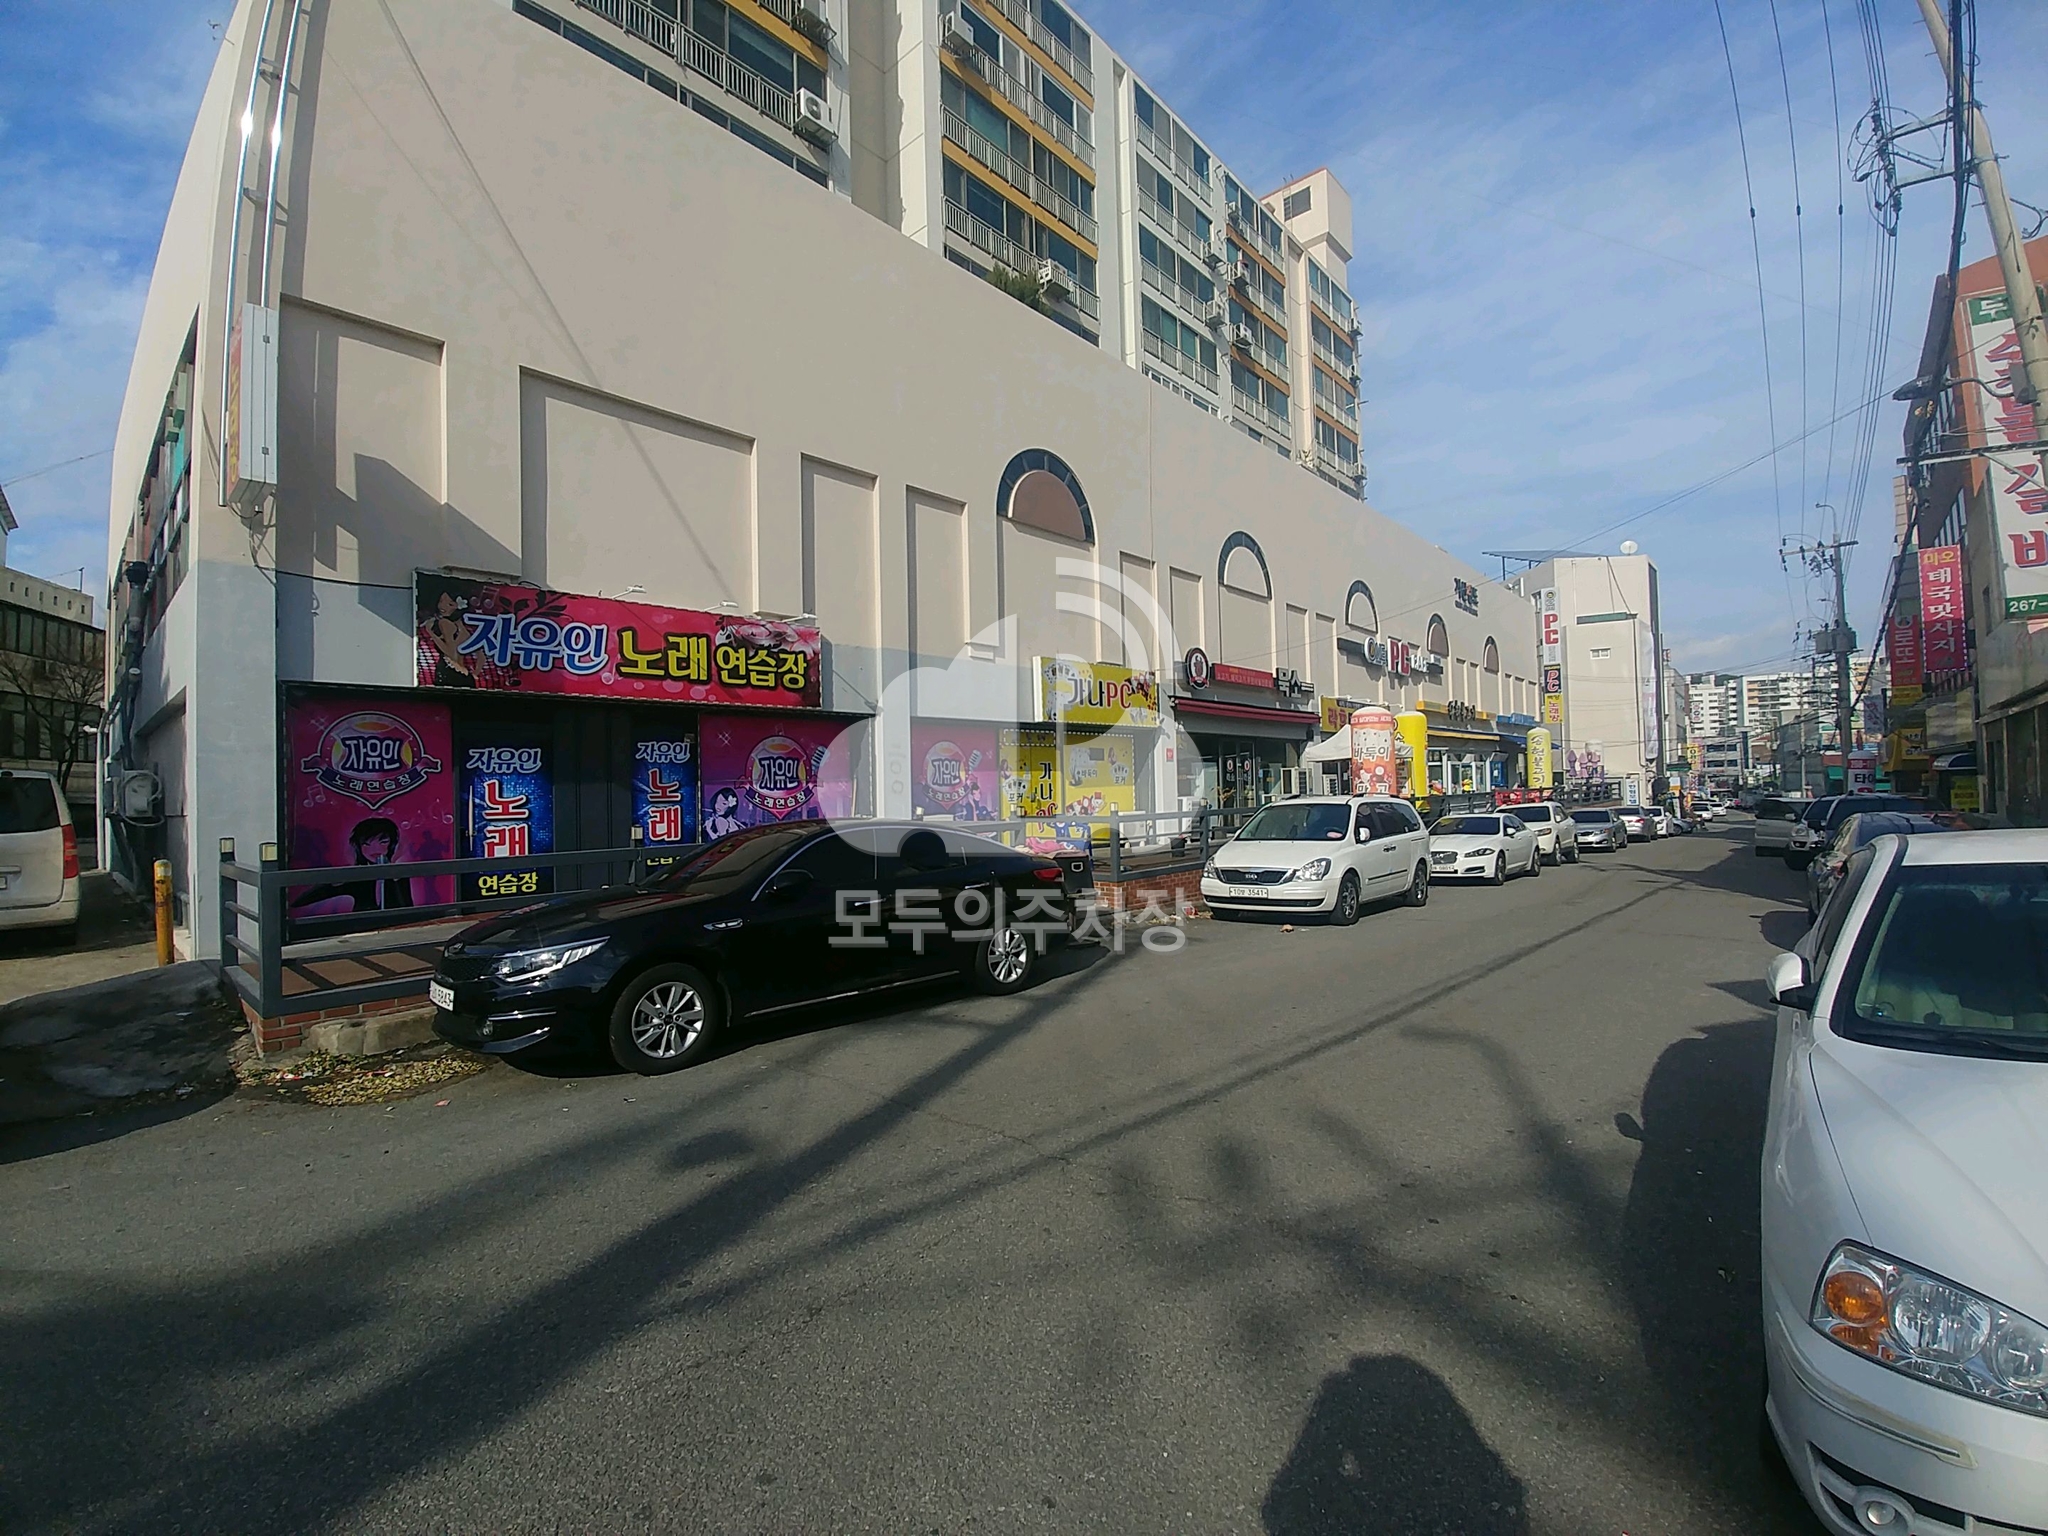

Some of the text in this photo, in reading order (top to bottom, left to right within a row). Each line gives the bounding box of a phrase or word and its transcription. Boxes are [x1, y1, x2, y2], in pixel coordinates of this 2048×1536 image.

[1922, 550, 1956, 565] 미오
[1926, 567, 1958, 653] 태국맛사지
[1544, 613, 1559, 645] PC
[458, 612, 808, 689] 자유인 노래 연습장
[1387, 637, 1411, 676] PC
[1894, 631, 1916, 664] 로또
[1067, 677, 1132, 709] 가나PC
[1546, 670, 1560, 692] PC
[343, 737, 402, 772] 자유인
[466, 747, 542, 773] 자유인
[635, 740, 691, 763] 자유인
[1353, 746, 1391, 761] 바둑이
[332, 774, 411, 792] 노래연습장
[759, 756, 799, 791] 자유인
[931, 758, 961, 786] 자유인
[647, 768, 681, 841] 노래
[752, 791, 806, 808] 노래연습장
[1007, 793, 1024, 803] 포커
[482, 779, 529, 858] 노래
[478, 872, 539, 896] 연습장
